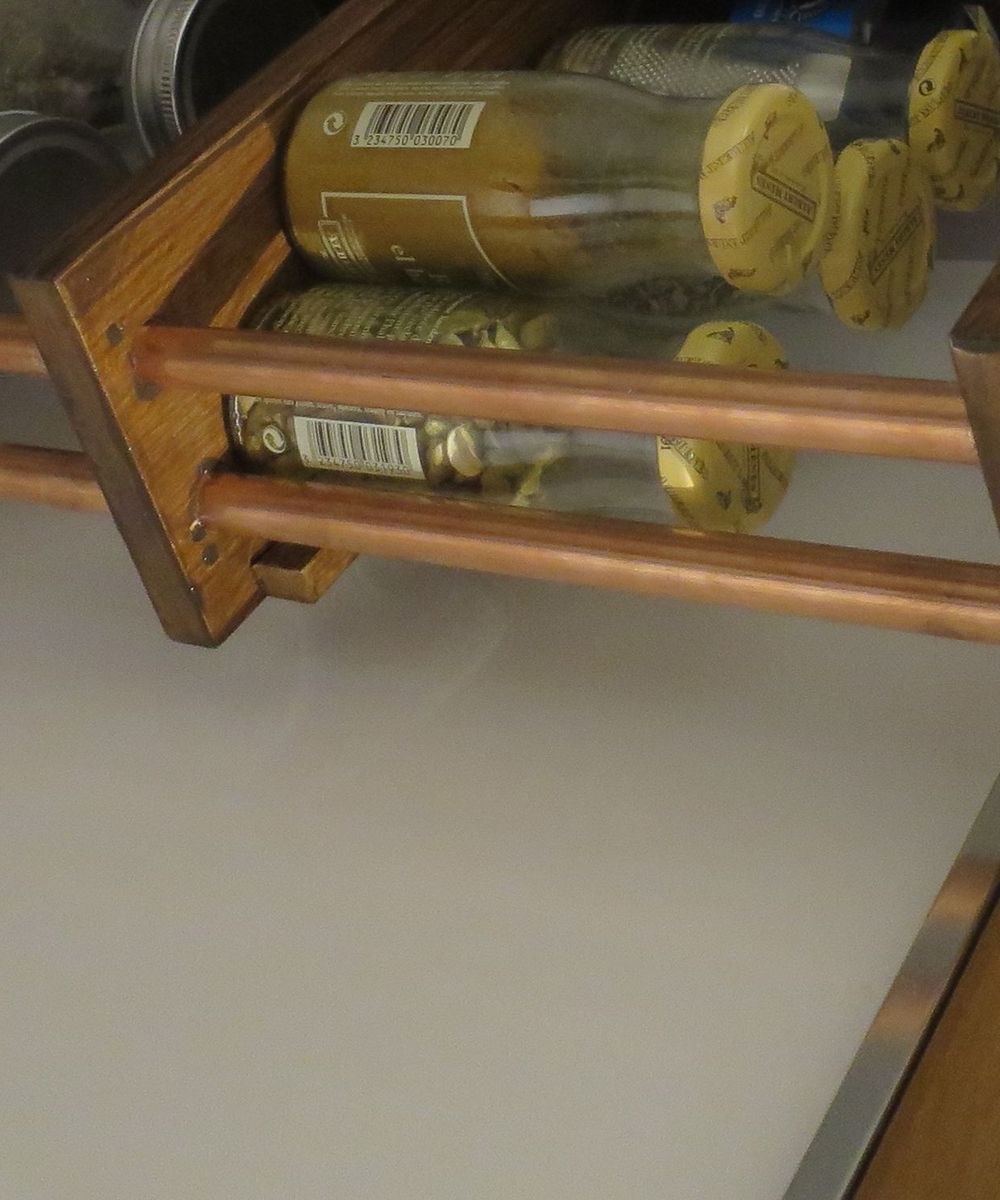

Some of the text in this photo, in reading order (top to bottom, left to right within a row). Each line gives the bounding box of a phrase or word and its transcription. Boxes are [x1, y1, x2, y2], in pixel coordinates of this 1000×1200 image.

[352, 134, 458, 146] 3 234750 030070
